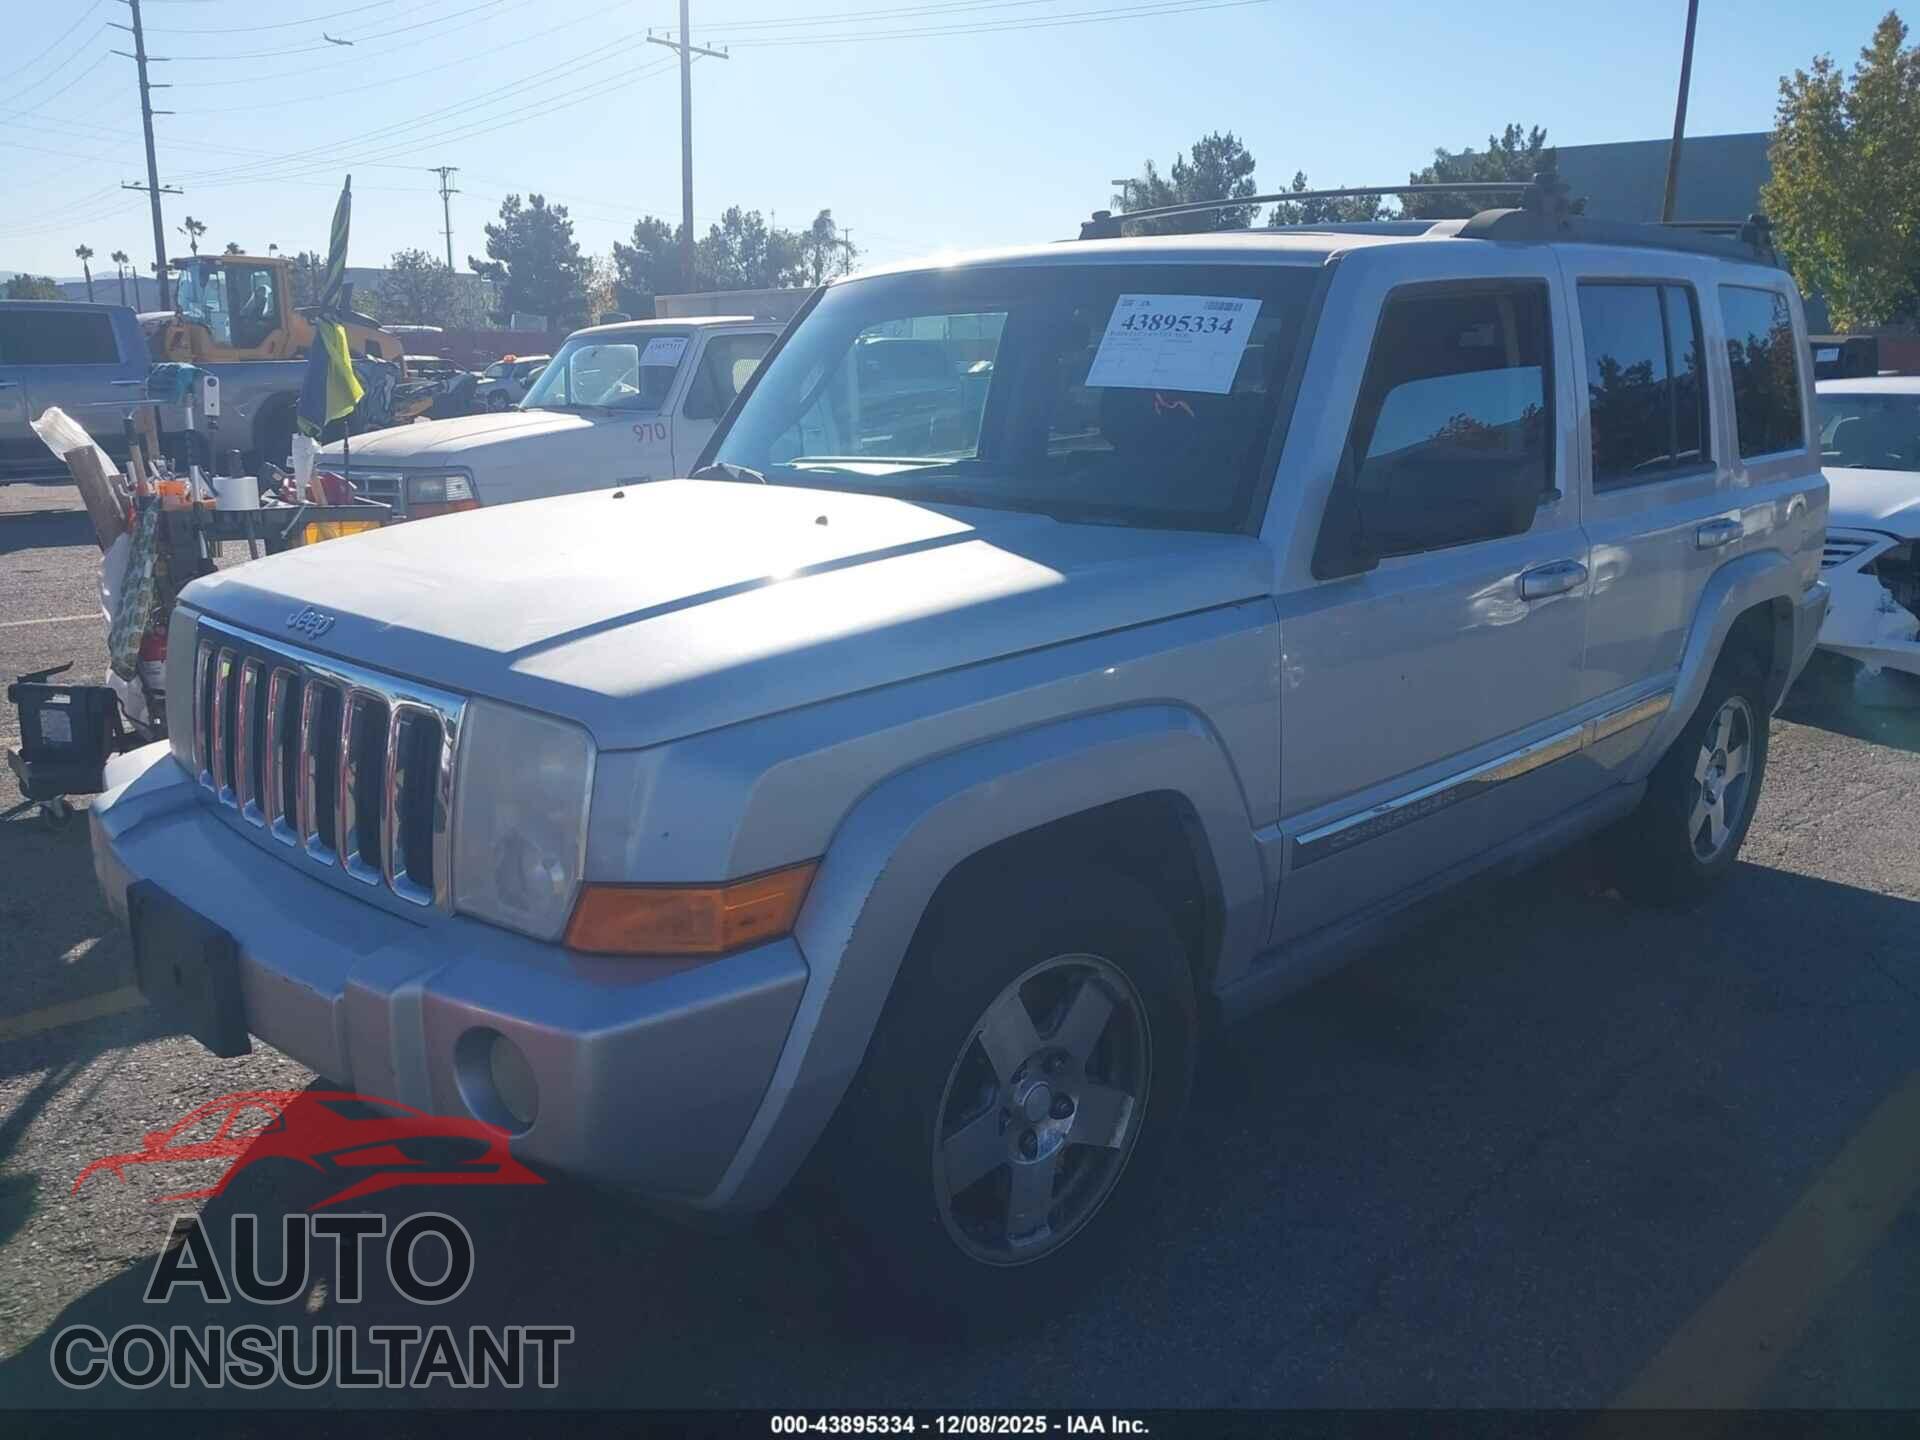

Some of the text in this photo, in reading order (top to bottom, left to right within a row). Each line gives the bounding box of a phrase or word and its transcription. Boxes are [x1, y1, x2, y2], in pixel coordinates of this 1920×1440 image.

[1121, 314, 1233, 334] 43895334
[632, 422, 666, 443] 970
[286, 604, 335, 639] Jeep
